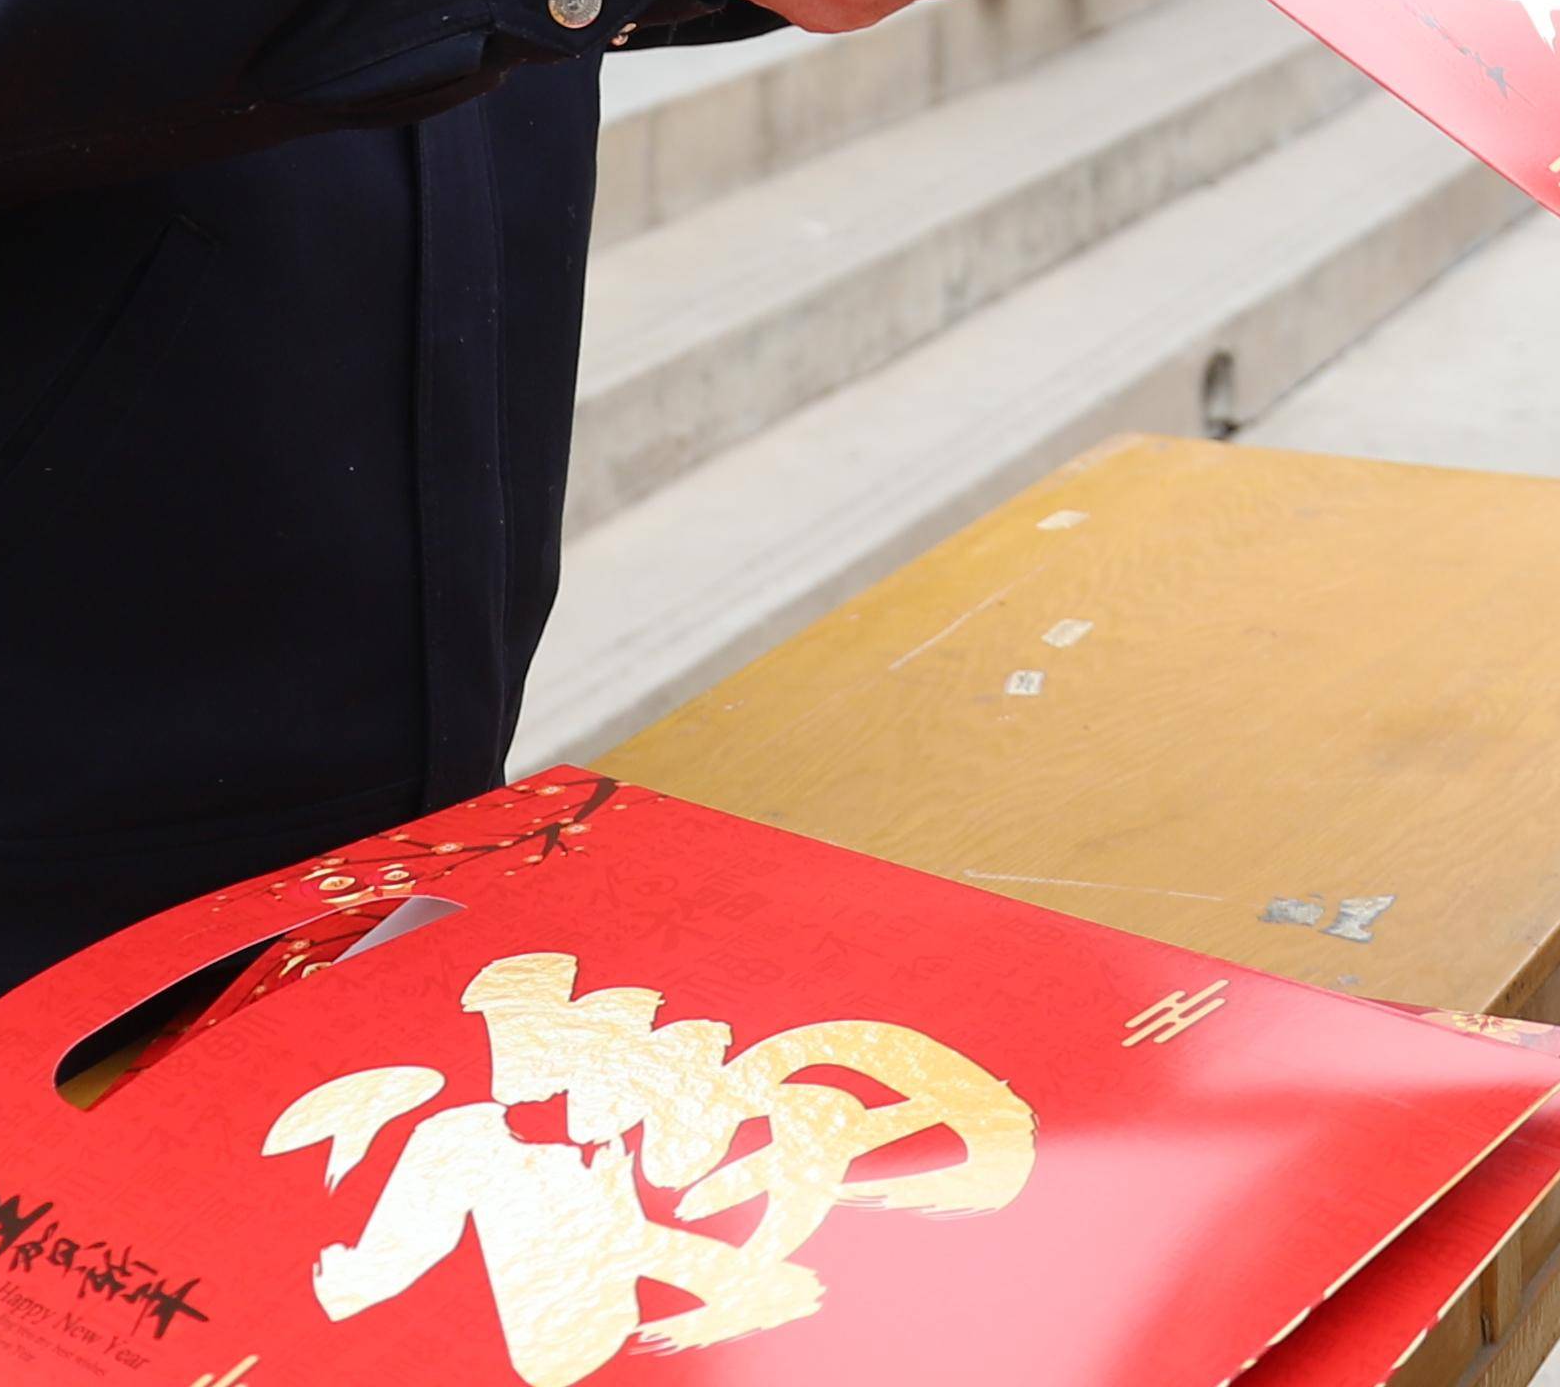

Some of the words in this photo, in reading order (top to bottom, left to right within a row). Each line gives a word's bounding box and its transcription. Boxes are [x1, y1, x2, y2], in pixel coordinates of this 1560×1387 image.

[258, 951, 1040, 1387] 福
[53, 1311, 105, 1345] New
[103, 1334, 151, 1371] Year
